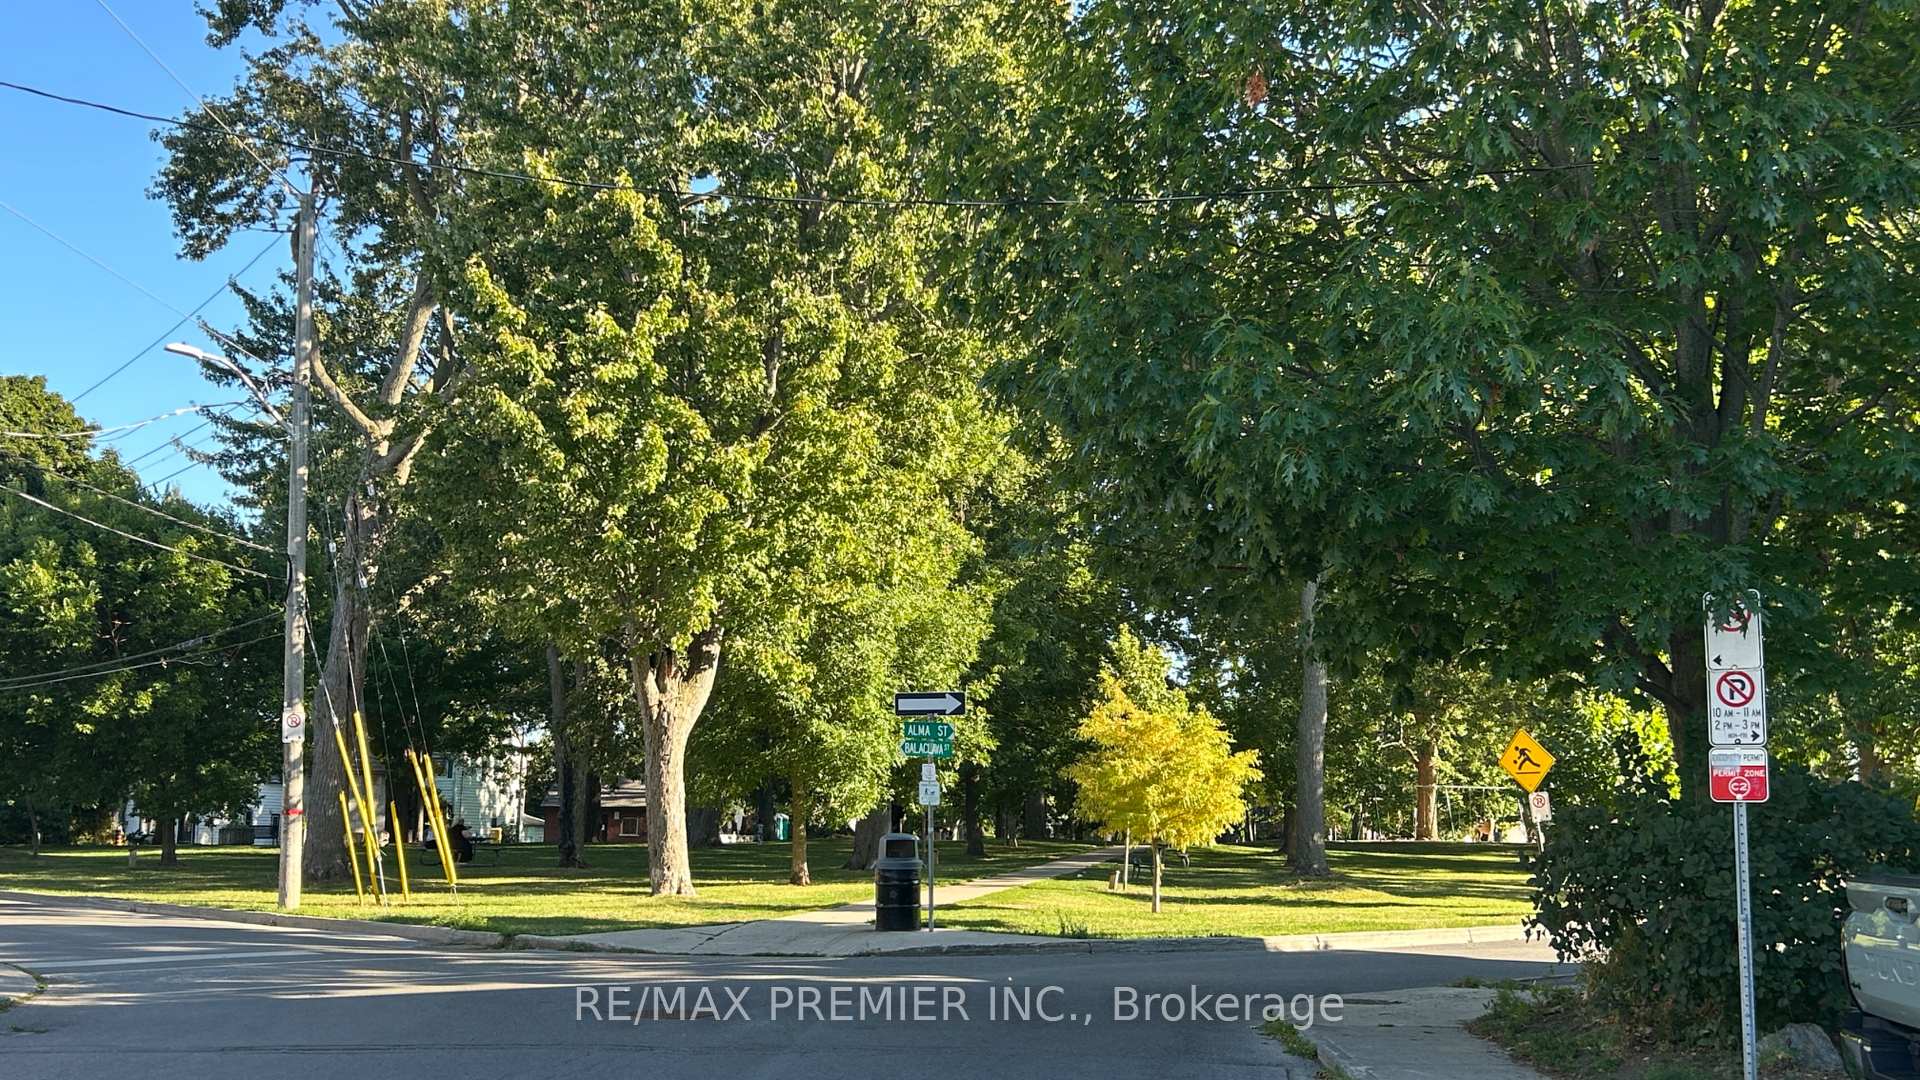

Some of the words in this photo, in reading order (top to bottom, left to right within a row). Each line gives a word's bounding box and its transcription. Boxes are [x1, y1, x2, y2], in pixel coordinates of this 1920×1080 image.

[1712, 707, 1721, 718] 10
[1724, 709, 1733, 718] AM
[1743, 707, 1749, 718] 11
[1752, 709, 1761, 718] AM
[908, 724, 930, 736] ALMA
[938, 725, 948, 736] ST
[1714, 719, 1721, 730] 2
[1723, 721, 1733, 729] PM
[1742, 719, 1748, 730] 3
[1751, 721, 1760, 729] PM
[904, 742, 943, 754] BALACLAVA
[1713, 768, 1740, 777] PERMIT
[1744, 769, 1765, 777] ZONE
[1731, 782, 1748, 791] C2
